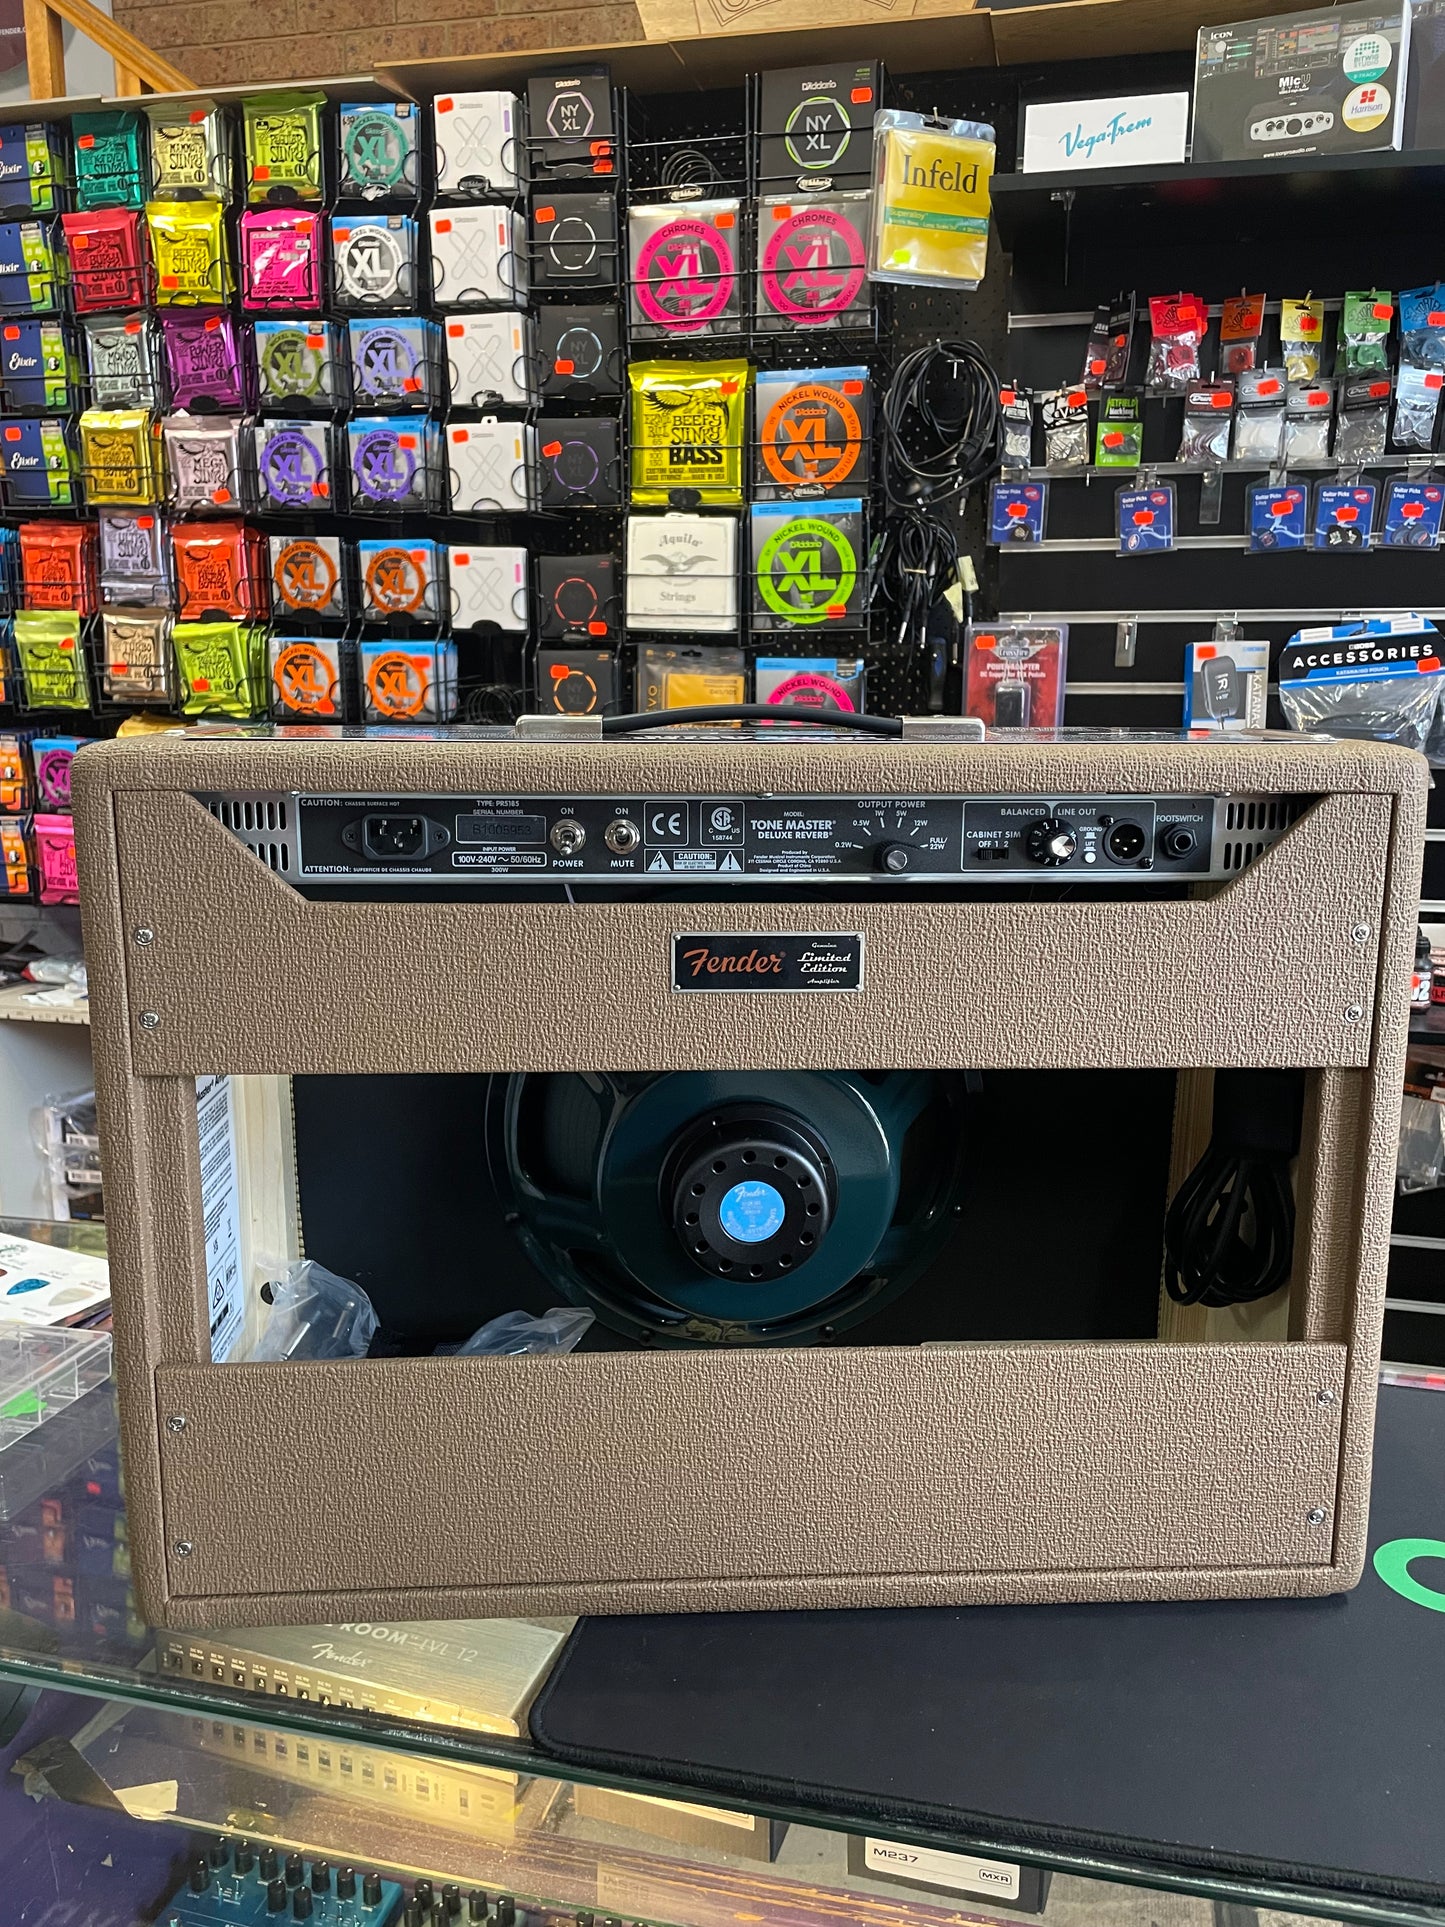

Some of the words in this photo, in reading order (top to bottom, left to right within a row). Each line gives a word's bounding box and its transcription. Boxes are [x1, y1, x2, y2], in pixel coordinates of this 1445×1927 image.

[802, 80, 837, 91] D'Addario
[560, 104, 579, 118] NY
[1351, 103, 1383, 114] Harrison
[562, 118, 581, 132] XL
[806, 114, 832, 133] NY
[357, 135, 395, 165] XL
[806, 134, 831, 150] XL
[902, 154, 980, 194] Infeld
[792, 215, 837, 228] CHROMES
[662, 224, 706, 238] CHROMES
[350, 248, 392, 279] XL
[782, 245, 845, 289] XL
[654, 254, 715, 298] XL
[363, 331, 383, 344] NICKEL
[385, 330, 407, 344] WOUND
[9, 354, 37, 373] Elixir
[274, 352, 312, 380] XL
[367, 350, 407, 378] XL
[778, 390, 811, 411] NICKEL
[813, 389, 846, 409] WOUND
[795, 408, 828, 416] D'Addario
[673, 415, 722, 426] BEEFY
[671, 427, 720, 445] SLINKY
[780, 418, 842, 461] XL
[11, 453, 39, 469] Elixir
[669, 445, 723, 466] BASS
[273, 454, 312, 482] XL
[366, 452, 404, 480] XL
[659, 533, 700, 547] Aquila
[774, 523, 805, 543] NICKEL
[808, 523, 840, 542] WOUND
[790, 541, 823, 549] D'Addario
[287, 563, 325, 590] XL
[777, 551, 837, 592] XL
[377, 569, 414, 595] XL
[660, 591, 696, 604] Strings
[1293, 645, 1434, 668] ACCESSORIES
[286, 665, 324, 692] XL
[379, 671, 416, 698] XL
[778, 679, 808, 696] NICKEL
[811, 679, 842, 698] WOUND
[858, 801, 892, 809] OUTPUT
[895, 801, 926, 809] POWER
[1000, 808, 1046, 816] BALANCED
[1057, 808, 1076, 816] LINE
[1078, 808, 1097, 816] OUT
[652, 812, 681, 836] CE
[751, 820, 785, 830] TONE
[852, 819, 870, 827] 0.5W
[914, 819, 928, 827] 12W
[1156, 814, 1204, 822] FOOTSWITCH
[966, 831, 1002, 839] CABINET
[1005, 831, 1021, 839] SIM
[458, 855, 497, 864] 100V-240V
[510, 855, 542, 864] 50/60Hz
[553, 860, 584, 868] POWER
[610, 860, 635, 868] MUTE
[304, 865, 351, 873] ATTENTION:
[683, 949, 783, 977] Fender
[797, 952, 852, 962] Limited
[800, 963, 848, 973] Edition
[735, 1186, 768, 1202] Fender
[311, 1643, 369, 1667] Fender
[457, 1648, 479, 1662] 12
[873, 1847, 918, 1863] M237
[982, 1872, 1009, 1883] MXR
